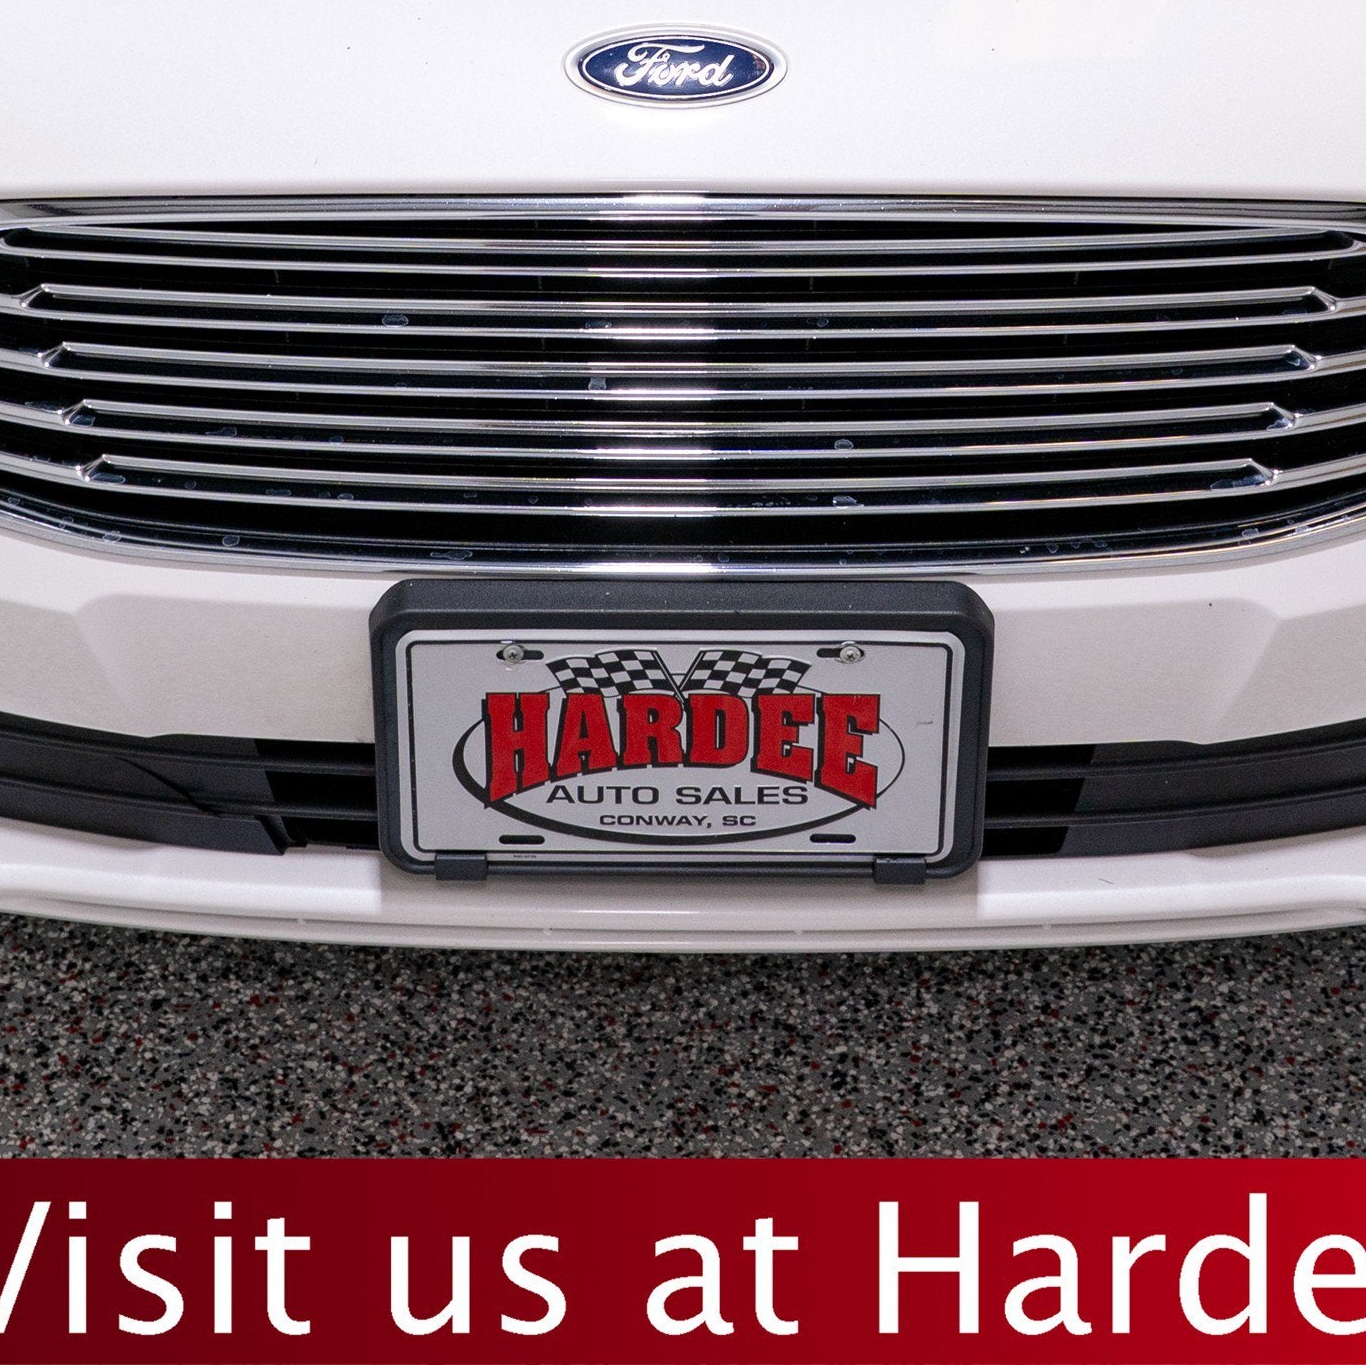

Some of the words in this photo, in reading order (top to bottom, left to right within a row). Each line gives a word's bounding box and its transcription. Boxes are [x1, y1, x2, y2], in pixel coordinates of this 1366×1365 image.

[615, 42, 735, 87] Ford
[483, 691, 882, 809] HARDEE
[545, 784, 660, 805] AUTO
[674, 784, 809, 806] SALES
[599, 814, 712, 829] CONWAY,
[721, 814, 757, 827] SC
